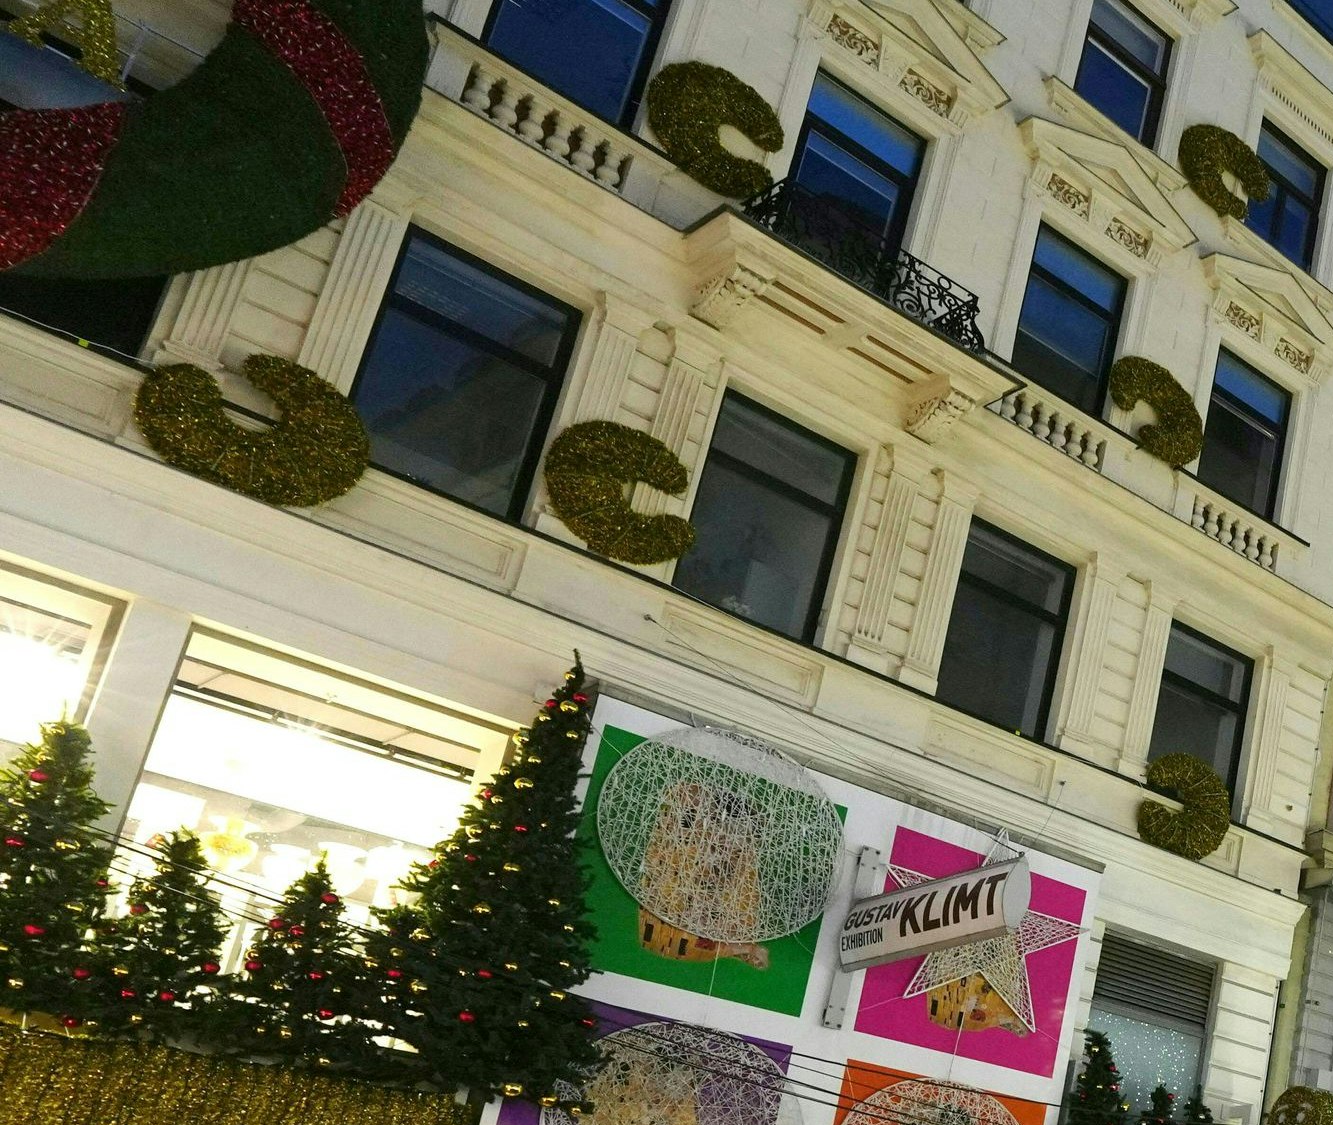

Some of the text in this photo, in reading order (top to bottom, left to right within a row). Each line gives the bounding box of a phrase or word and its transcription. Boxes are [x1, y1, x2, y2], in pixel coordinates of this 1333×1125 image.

[844, 872, 1009, 937] GUSTAV KLIMT
[841, 927, 883, 951] EXHIBITION
